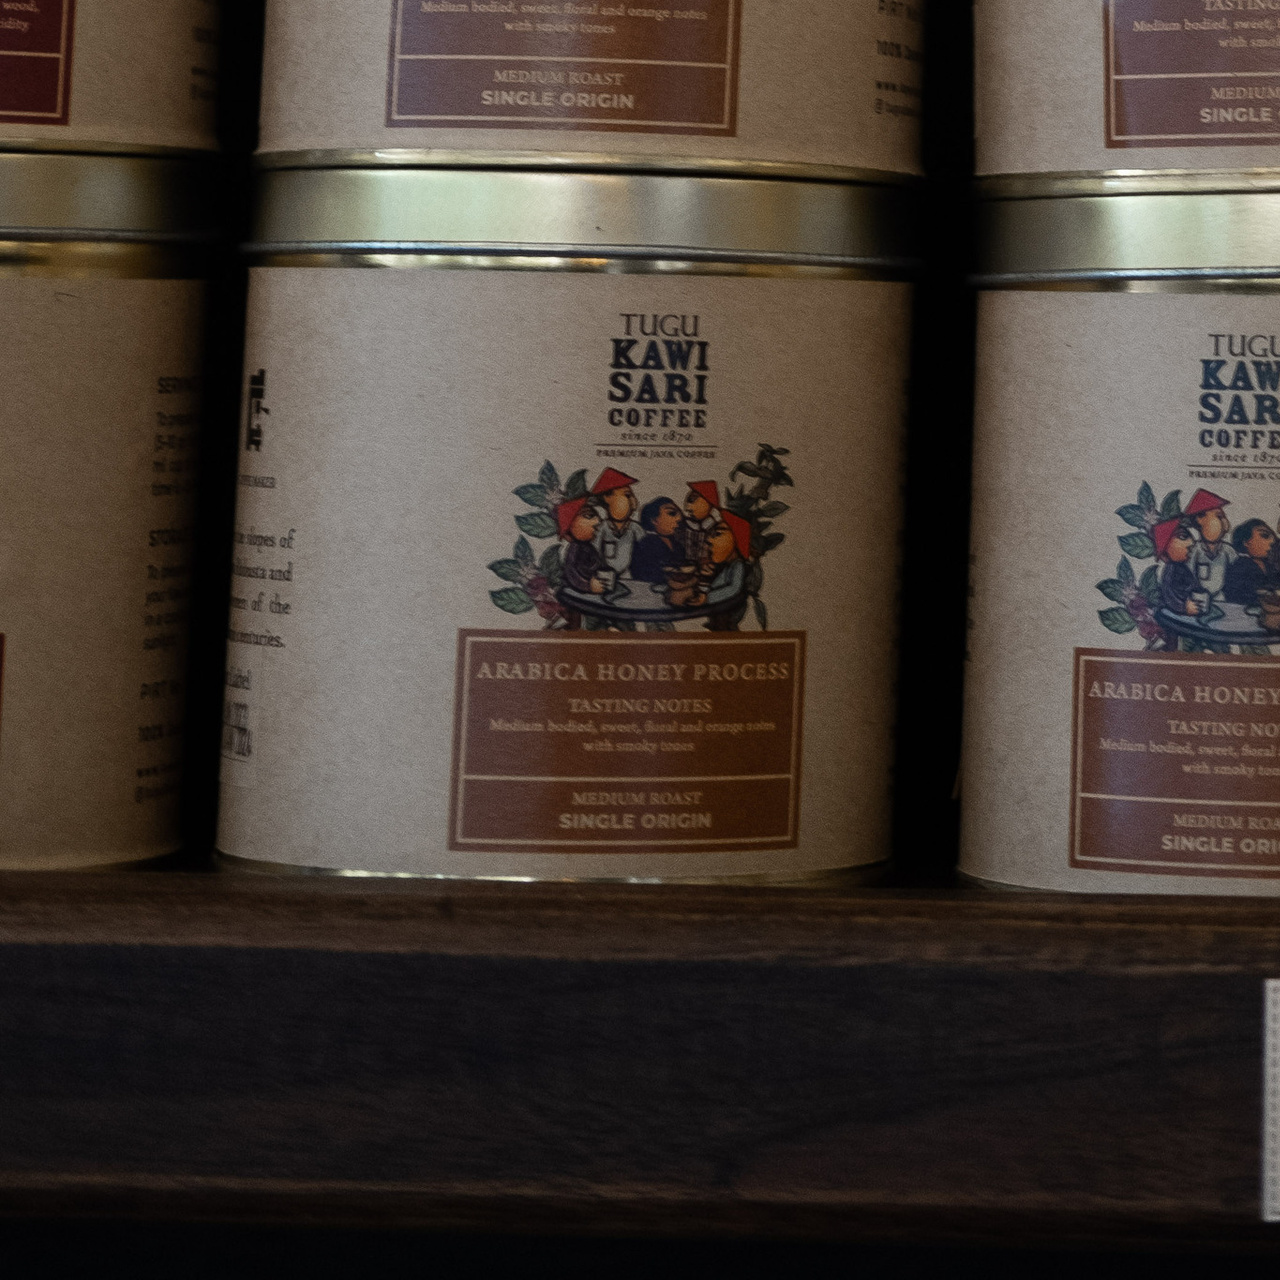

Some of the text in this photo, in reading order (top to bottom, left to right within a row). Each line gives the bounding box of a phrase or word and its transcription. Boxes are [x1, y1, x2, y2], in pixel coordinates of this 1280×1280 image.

[494, 70, 624, 86] MEDIUM ROAST
[481, 90, 634, 109] SINGLE ORIGIN
[1200, 107, 1272, 123] SINGLE
[619, 314, 699, 337] TUGU
[610, 338, 709, 371] KAWI
[608, 372, 708, 405] SARI
[608, 408, 707, 428] COFFEE
[476, 662, 790, 682] ARABICA HONEY PROCESS
[1088, 681, 1186, 702] ARABICA
[567, 698, 713, 713] TASTING NOTES
[1167, 720, 1246, 737] TASTING
[572, 791, 704, 805] MEDIUM ROAST
[559, 813, 713, 830] SINGLE ORIGIN
[1173, 814, 1242, 830] MEDIUM
[1162, 835, 1234, 853] SINGLE
